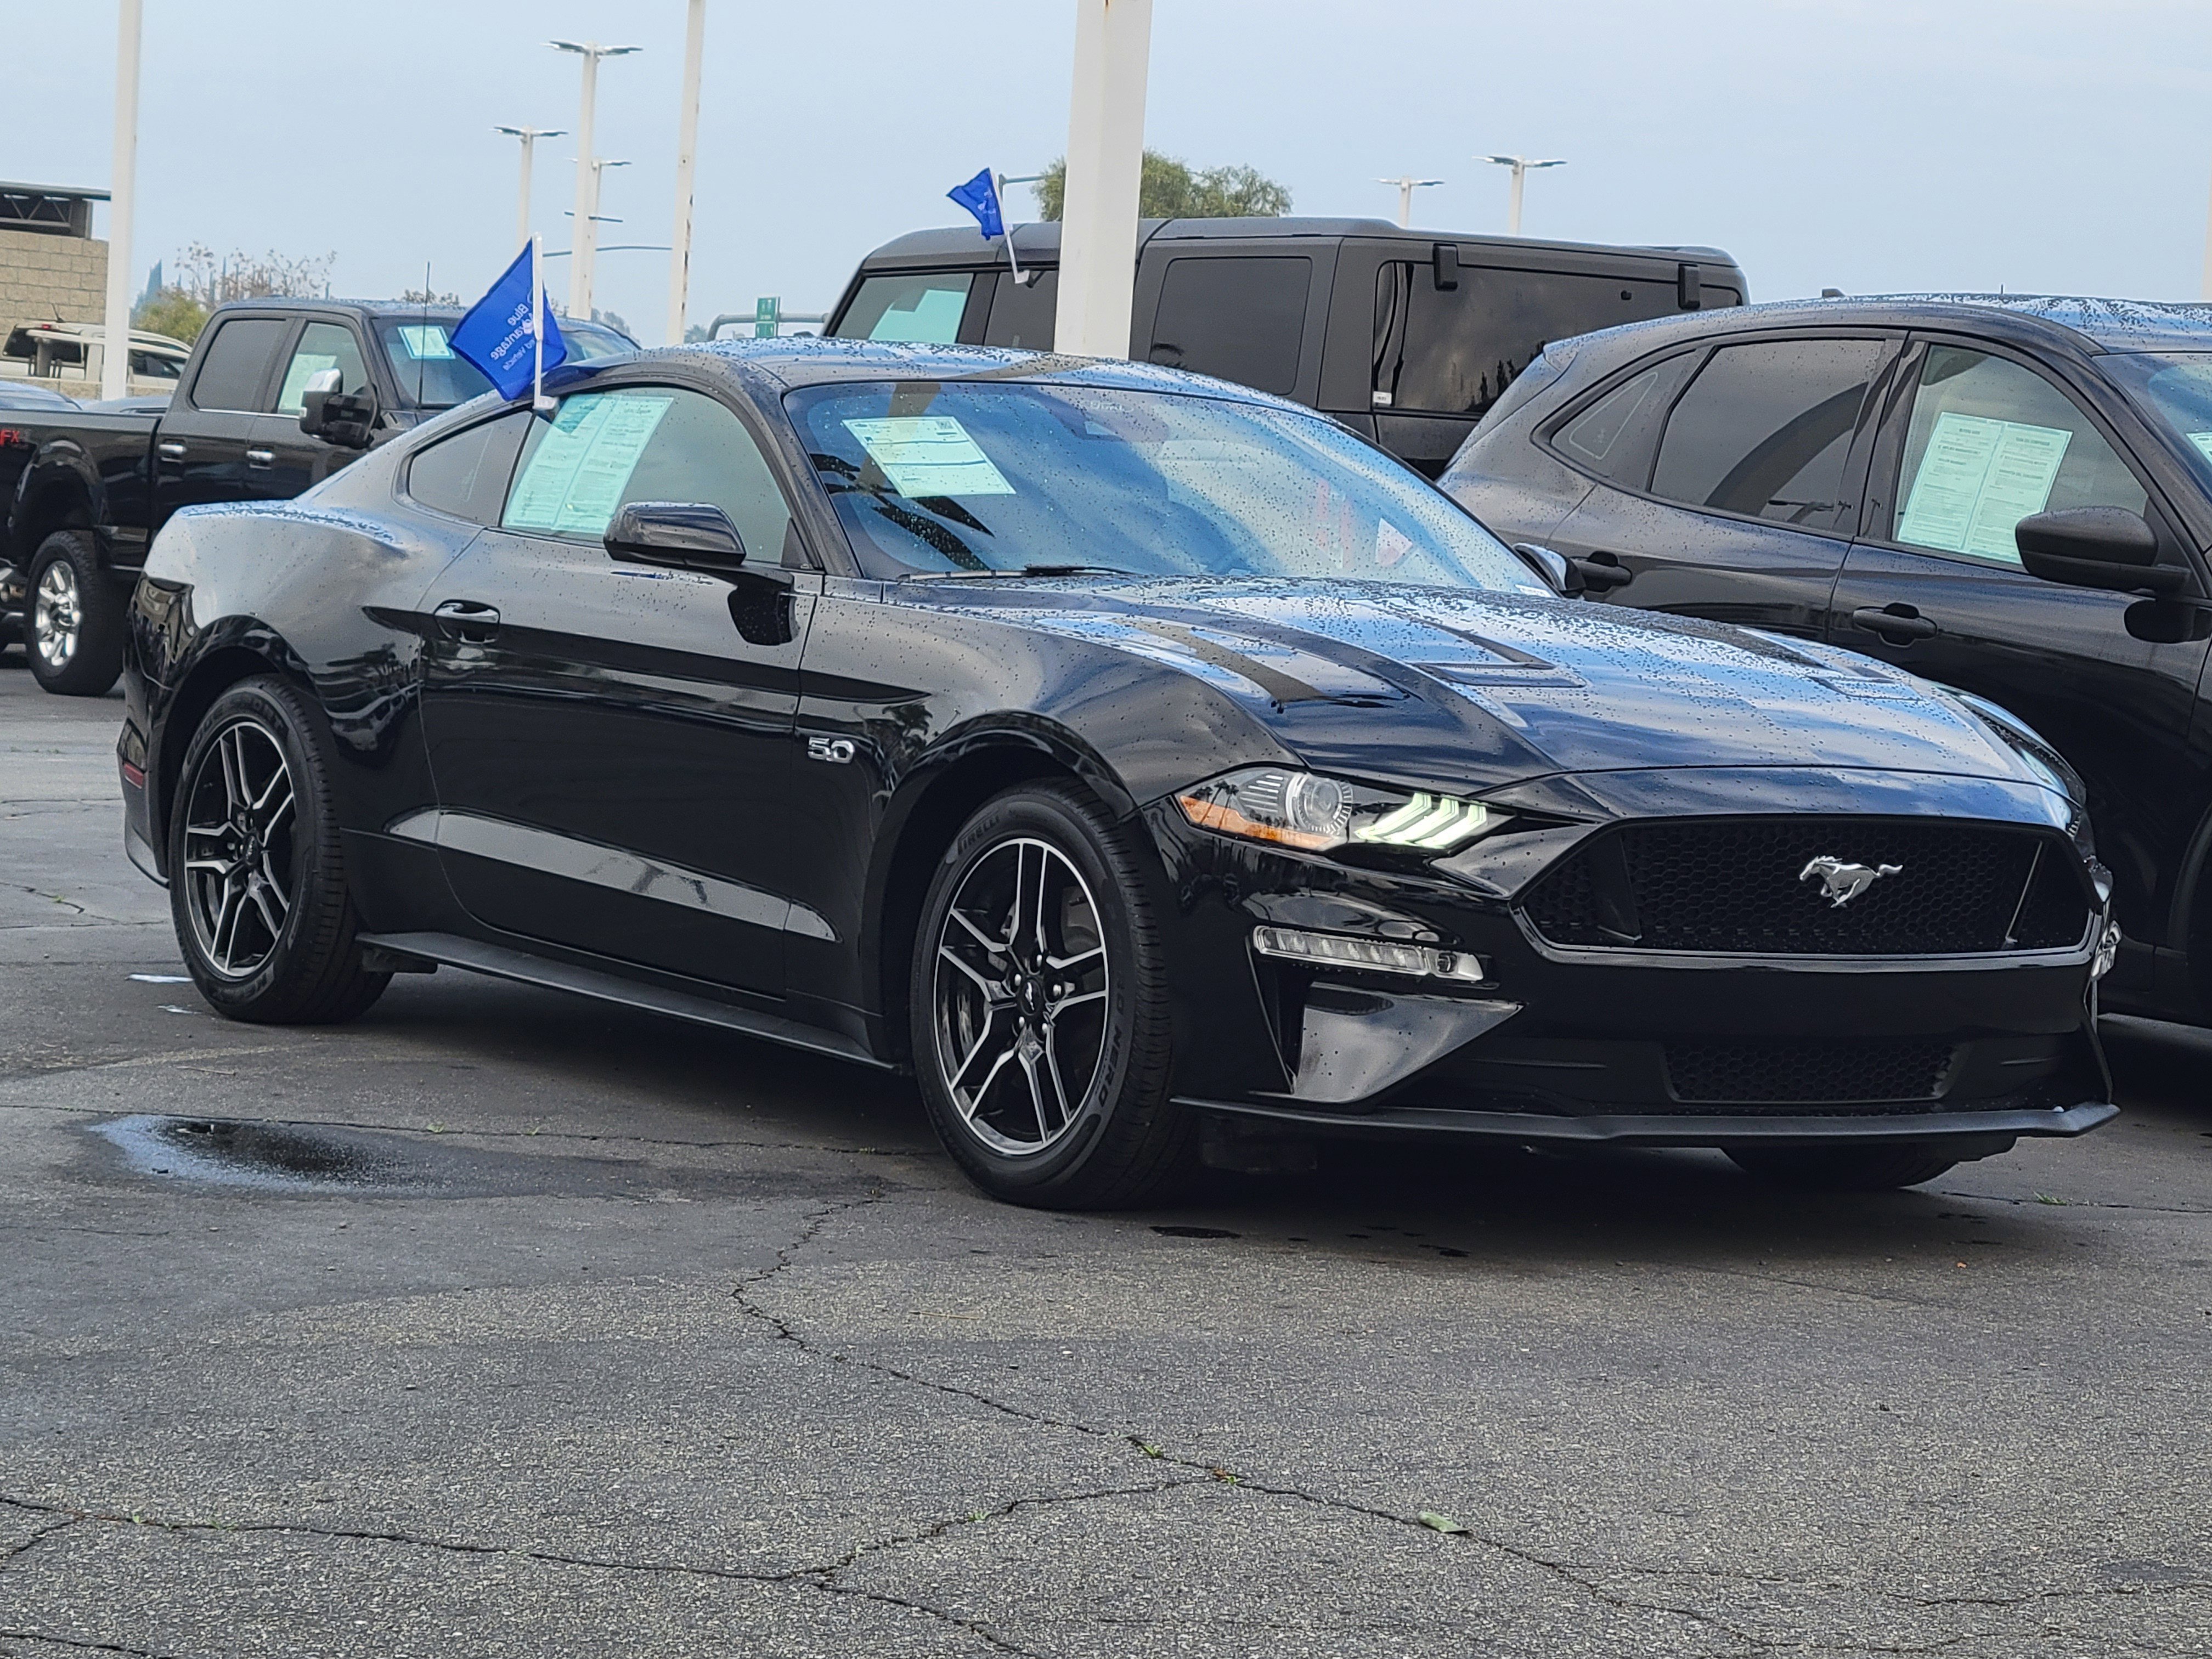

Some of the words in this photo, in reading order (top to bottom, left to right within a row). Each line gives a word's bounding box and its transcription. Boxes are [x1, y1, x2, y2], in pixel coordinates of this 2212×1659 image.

[808, 736, 855, 764] 5.0
[957, 809, 1000, 855] PIRELLI
[1098, 1024, 1122, 1108] NERO
